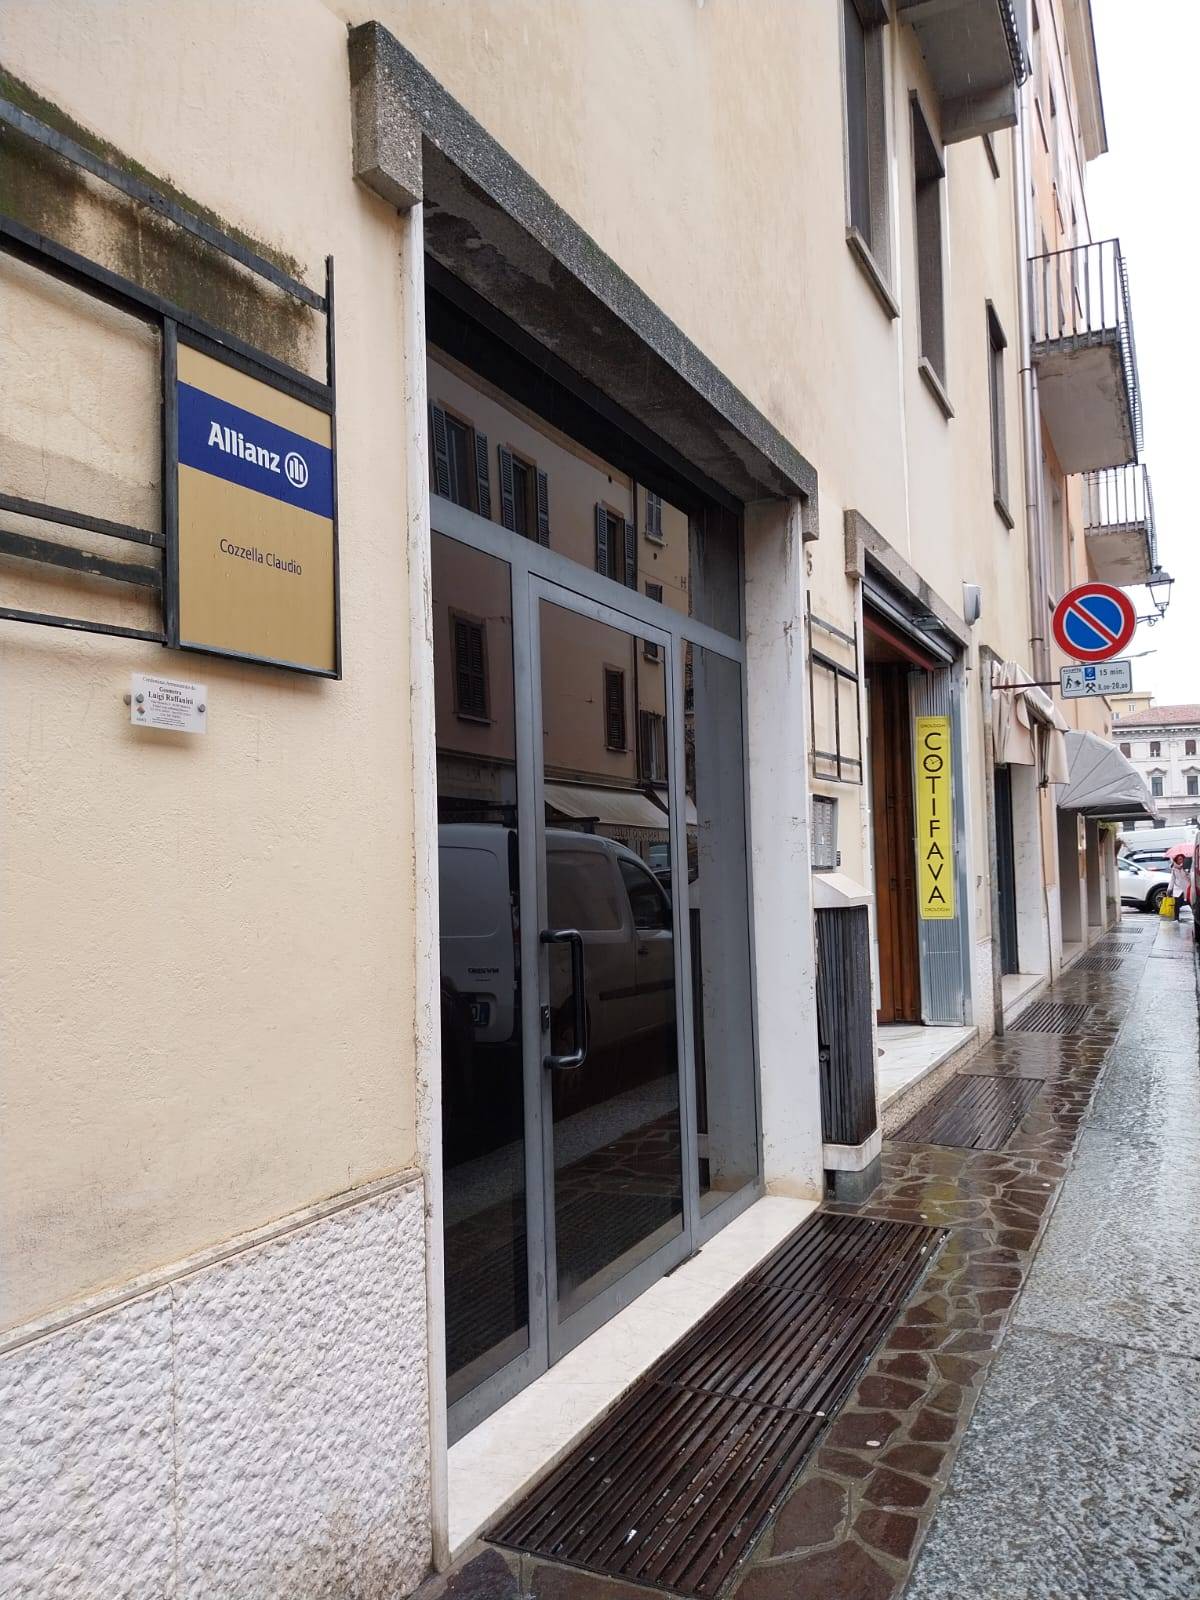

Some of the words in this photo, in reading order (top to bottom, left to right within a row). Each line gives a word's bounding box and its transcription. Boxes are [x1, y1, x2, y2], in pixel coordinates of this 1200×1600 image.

[207, 420, 280, 473] Allianz
[220, 539, 263, 564] Cozzella
[265, 553, 302, 576] Claudio
[148, 690, 164, 700] Luigi
[923, 732, 945, 903] COTIFAVA
